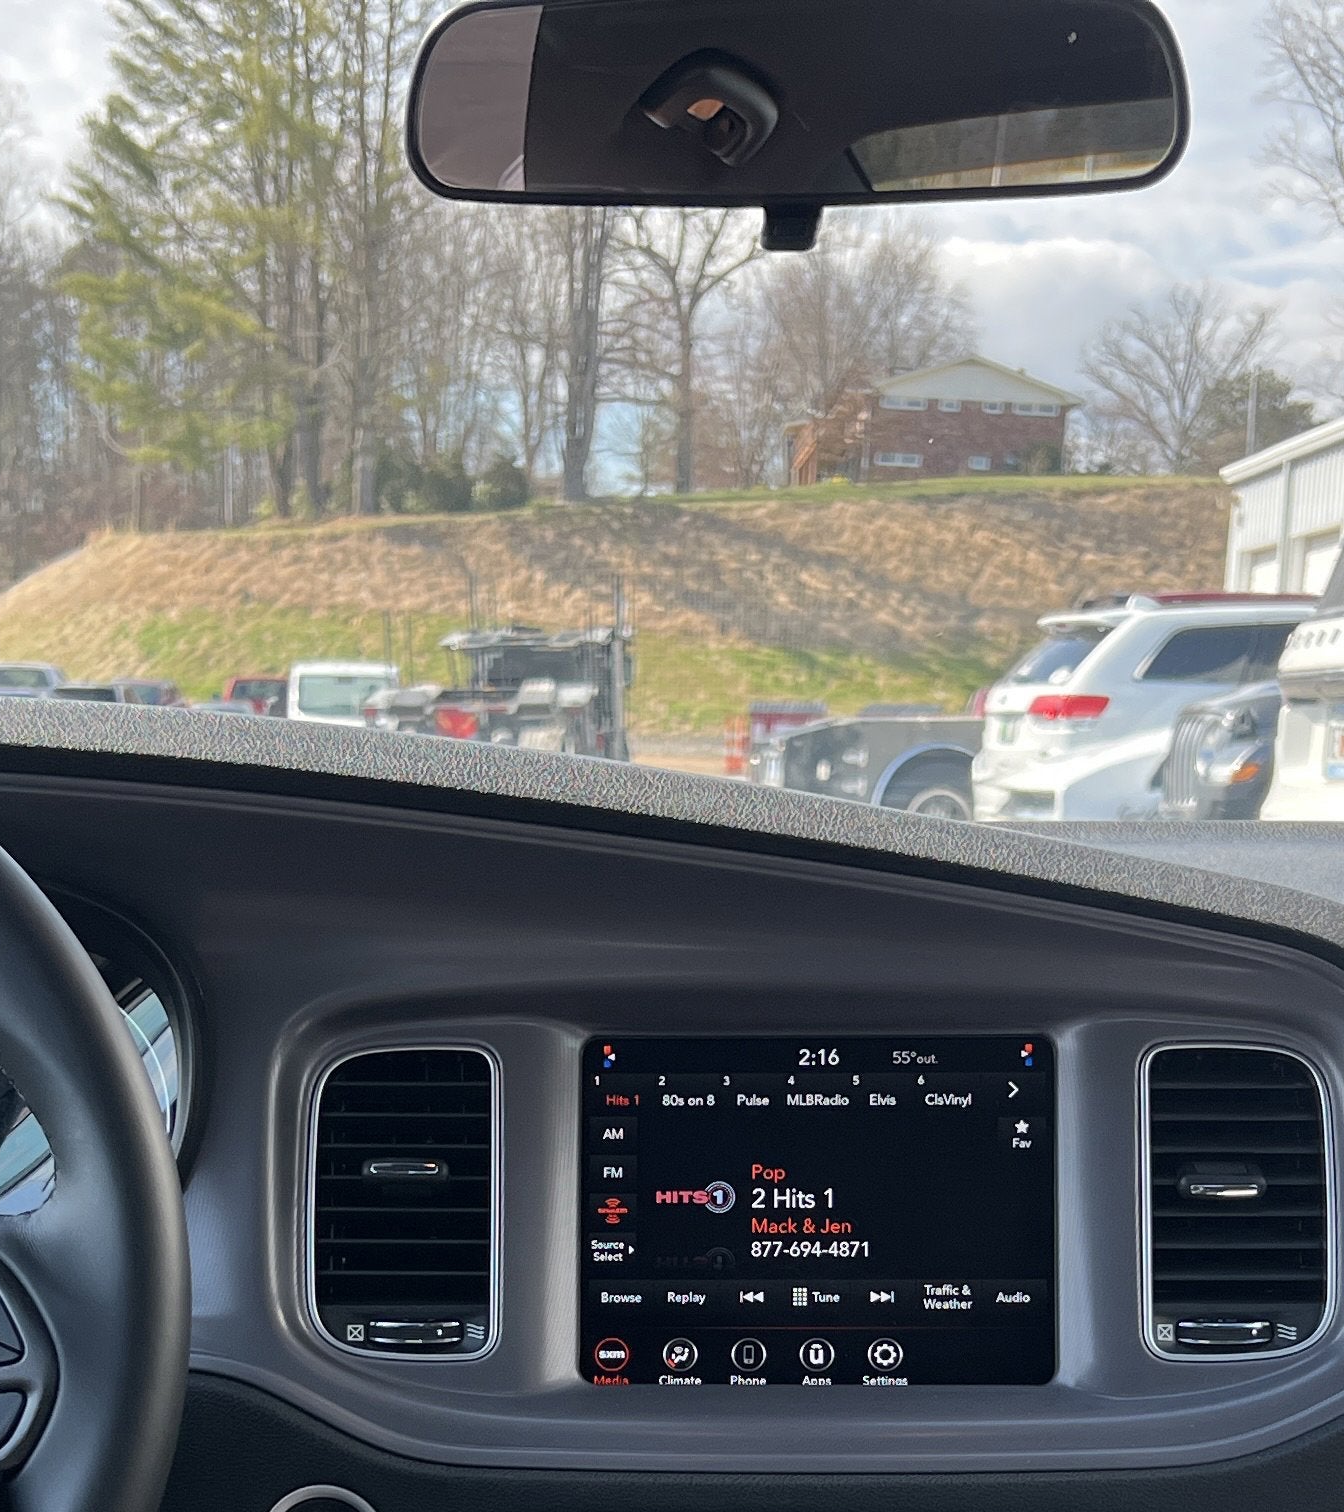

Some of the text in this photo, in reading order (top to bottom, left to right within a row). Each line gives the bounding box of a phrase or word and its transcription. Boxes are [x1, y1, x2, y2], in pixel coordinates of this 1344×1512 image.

[799, 1048, 840, 1066] 2:16
[594, 1075, 600, 1086] 1
[658, 1075, 666, 1086] 2
[723, 1075, 731, 1086] 3
[787, 1075, 795, 1086] 4
[852, 1074, 860, 1086] 5
[917, 1074, 925, 1086] 6
[606, 1094, 640, 1106] Hits 1
[662, 1094, 716, 1107] 80s on 8
[736, 1094, 770, 1107] Pulse
[786, 1093, 850, 1107] MLBRadio
[869, 1093, 897, 1106] Elvis
[924, 1093, 972, 1108] ClsVinyl
[602, 1127, 625, 1140] AM
[1012, 1138, 1032, 1149] Fav
[603, 1166, 624, 1179] FM
[751, 1164, 786, 1184] Pop
[656, 1190, 724, 1205] HITS 1
[751, 1188, 833, 1209] 2 Hits 1
[751, 1217, 852, 1234] Mack & Jen
[591, 1240, 625, 1250] Source
[750, 1241, 870, 1258] 877-694-4871
[593, 1251, 623, 1262] Select
[923, 1284, 972, 1296] Traffic &
[601, 1291, 643, 1304] Browse
[667, 1291, 706, 1306] Replay
[812, 1291, 840, 1303] Tune
[996, 1291, 1031, 1303] Audio
[923, 1298, 973, 1310] Weather
[598, 1350, 625, 1360] sxm
[593, 1375, 629, 1385] Media
[659, 1376, 702, 1386] Climate
[730, 1376, 767, 1386] Phone
[862, 1376, 908, 1386] Settings
